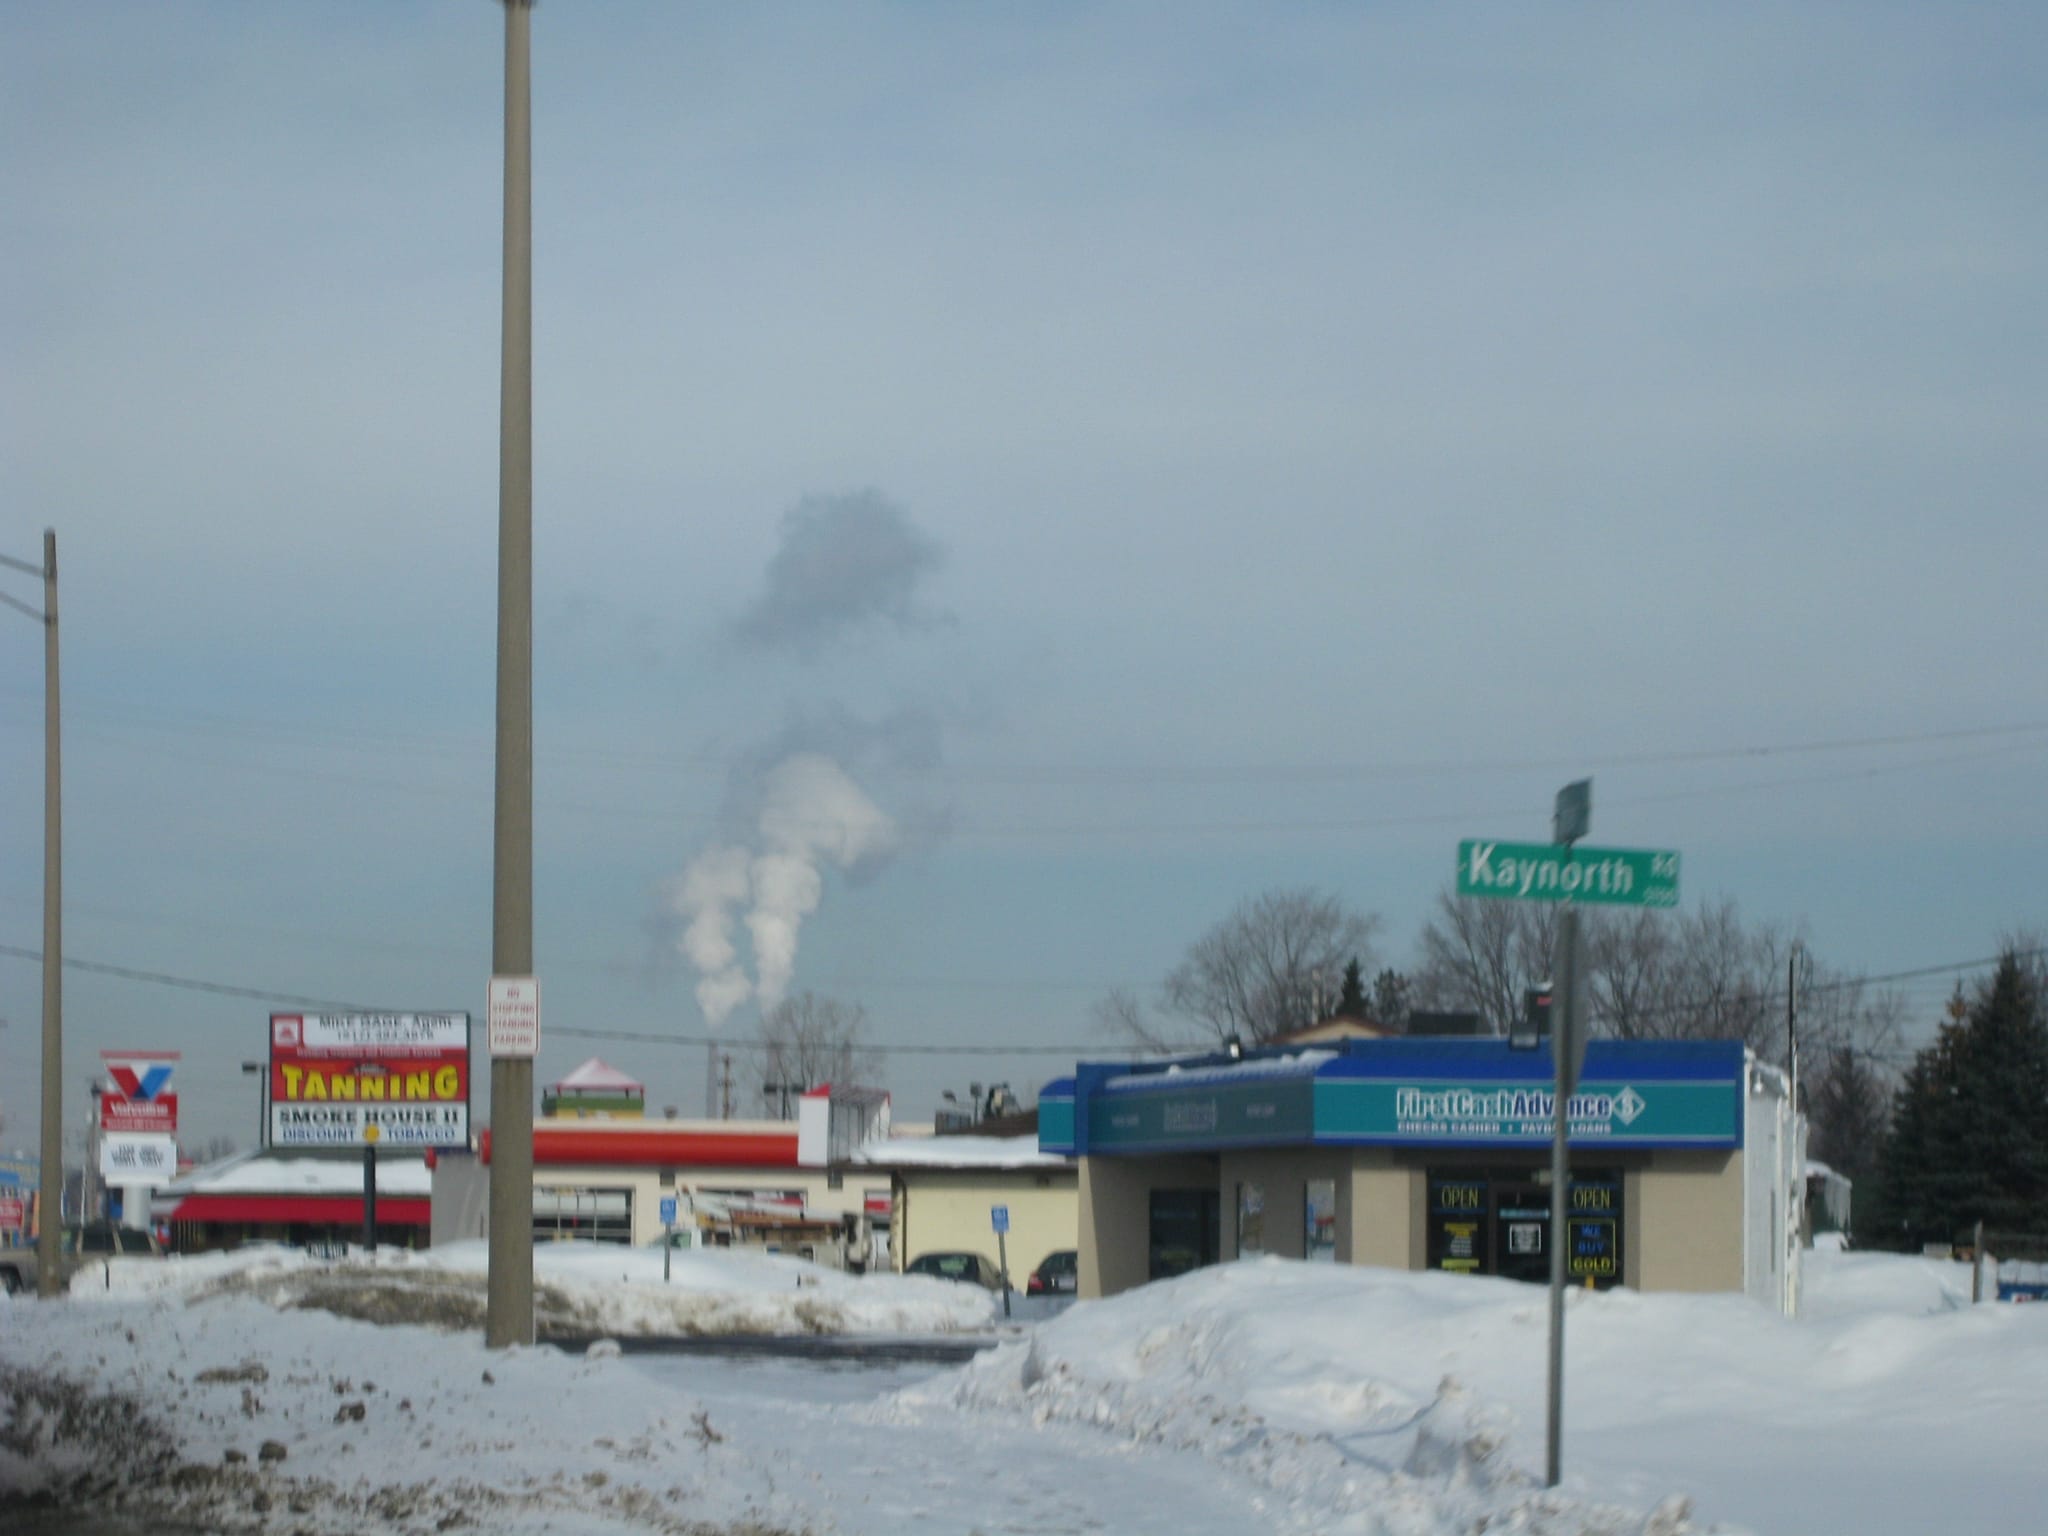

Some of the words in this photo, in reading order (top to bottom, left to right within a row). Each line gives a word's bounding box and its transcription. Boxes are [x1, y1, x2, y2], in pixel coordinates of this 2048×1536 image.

[1468, 842, 1634, 896] Kaynorth
[281, 1063, 459, 1101] TANNING
[279, 1108, 357, 1125] SMOKE
[364, 1108, 436, 1125] HOUSE
[283, 1126, 355, 1143] DISCOUNT
[387, 1126, 457, 1142] TOBACCO
[1441, 1187, 1479, 1208] OPEN
[1573, 1187, 1611, 1209] OPEN
[1573, 1257, 1611, 1273] GOLD
